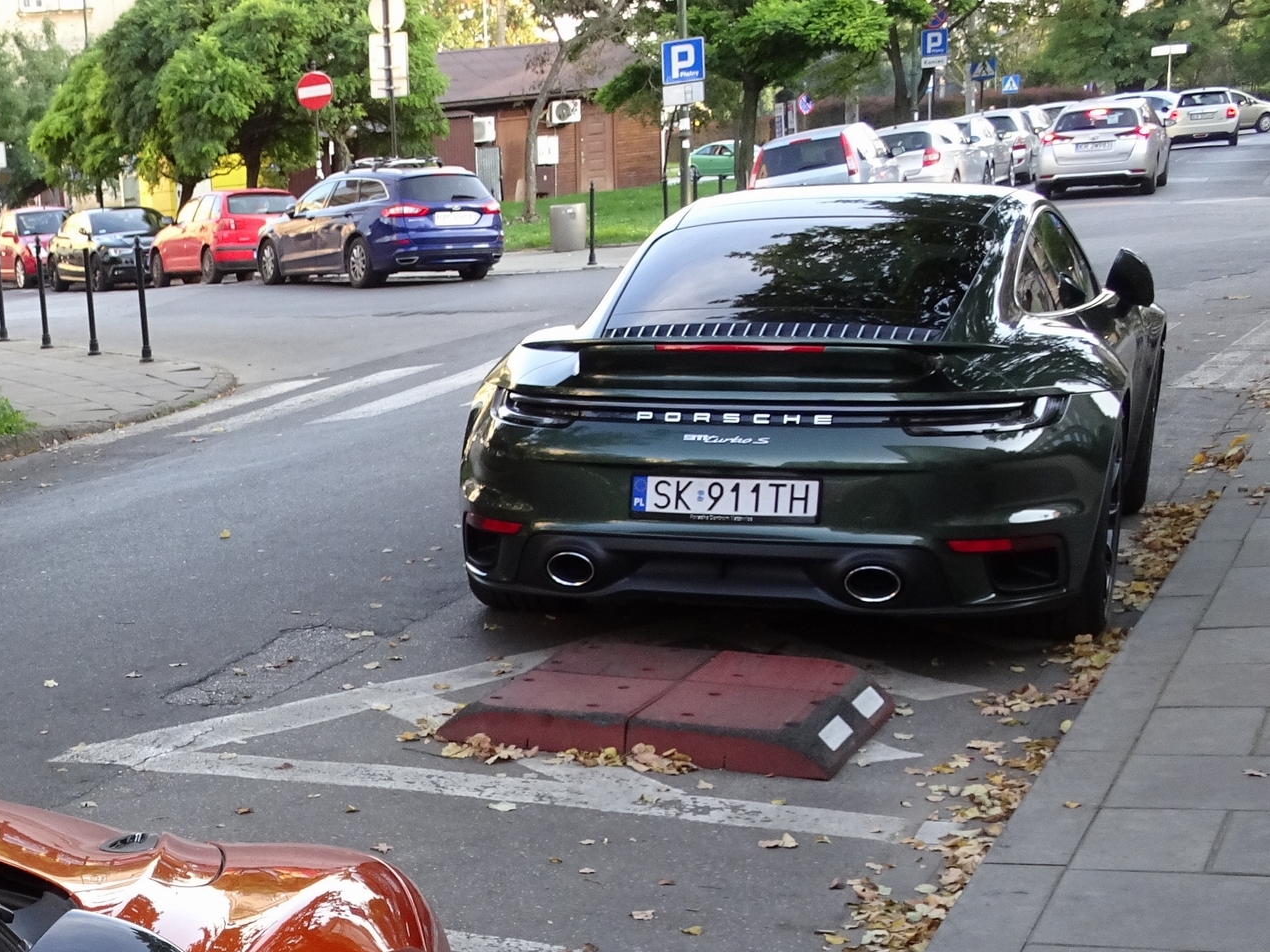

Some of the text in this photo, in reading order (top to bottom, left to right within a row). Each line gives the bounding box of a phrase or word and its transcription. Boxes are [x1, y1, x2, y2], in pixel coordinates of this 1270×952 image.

[671, 44, 695, 79] P
[636, 411, 833, 425] PORSCHE
[633, 497, 645, 507] PL
